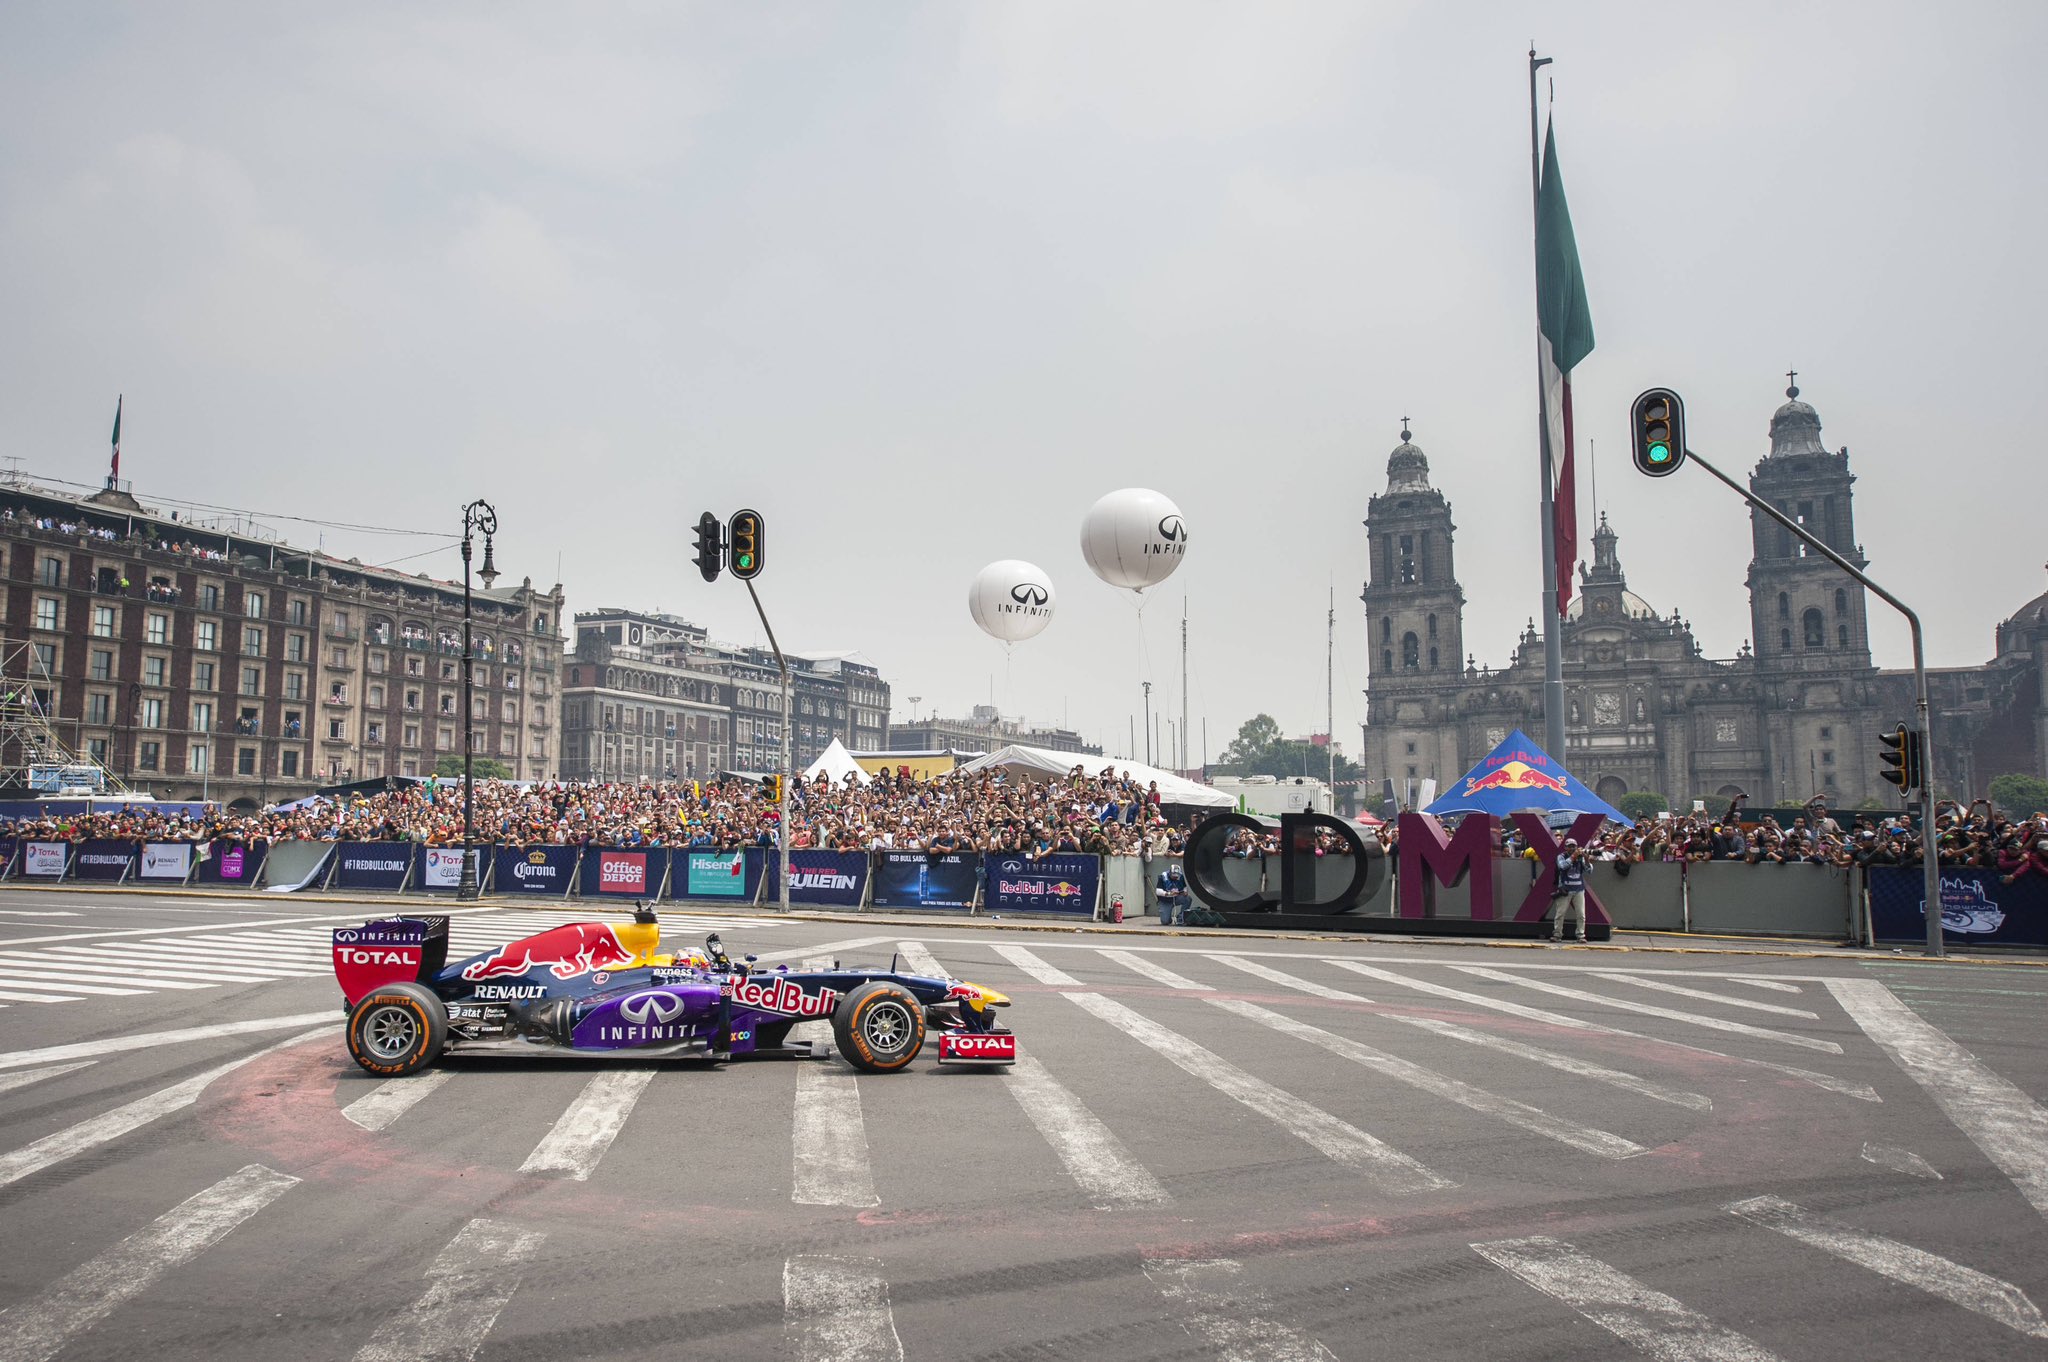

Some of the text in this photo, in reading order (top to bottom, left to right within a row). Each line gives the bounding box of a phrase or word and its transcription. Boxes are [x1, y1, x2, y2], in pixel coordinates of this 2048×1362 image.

[998, 603, 1052, 618] INFINITI
[1487, 751, 1547, 768] Red Bull
[37, 848, 60, 857] TOTAL
[889, 854, 900, 862] RED
[900, 855, 912, 863] BULL
[344, 859, 405, 872] #F1REDBULLCDMX
[441, 855, 464, 865] TOTA
[692, 858, 733, 870] Hisens
[513, 861, 557, 881] Corona
[602, 861, 643, 875] Office
[801, 867, 817, 875] THE
[1026, 863, 1082, 873] INFINITI
[1184, 813, 1612, 925] CDMX
[602, 873, 643, 883] DEPOT
[1000, 880, 1045, 895] Red Bull
[999, 895, 1082, 907] RACING
[362, 932, 422, 941] INFINITI
[337, 947, 417, 966] TOTAL
[473, 984, 548, 999] RENAULT
[729, 974, 838, 1016] Red Bull
[461, 1007, 482, 1018] at&t
[600, 1024, 697, 1041] INFINITI
[946, 1037, 1013, 1050] TOTAL
